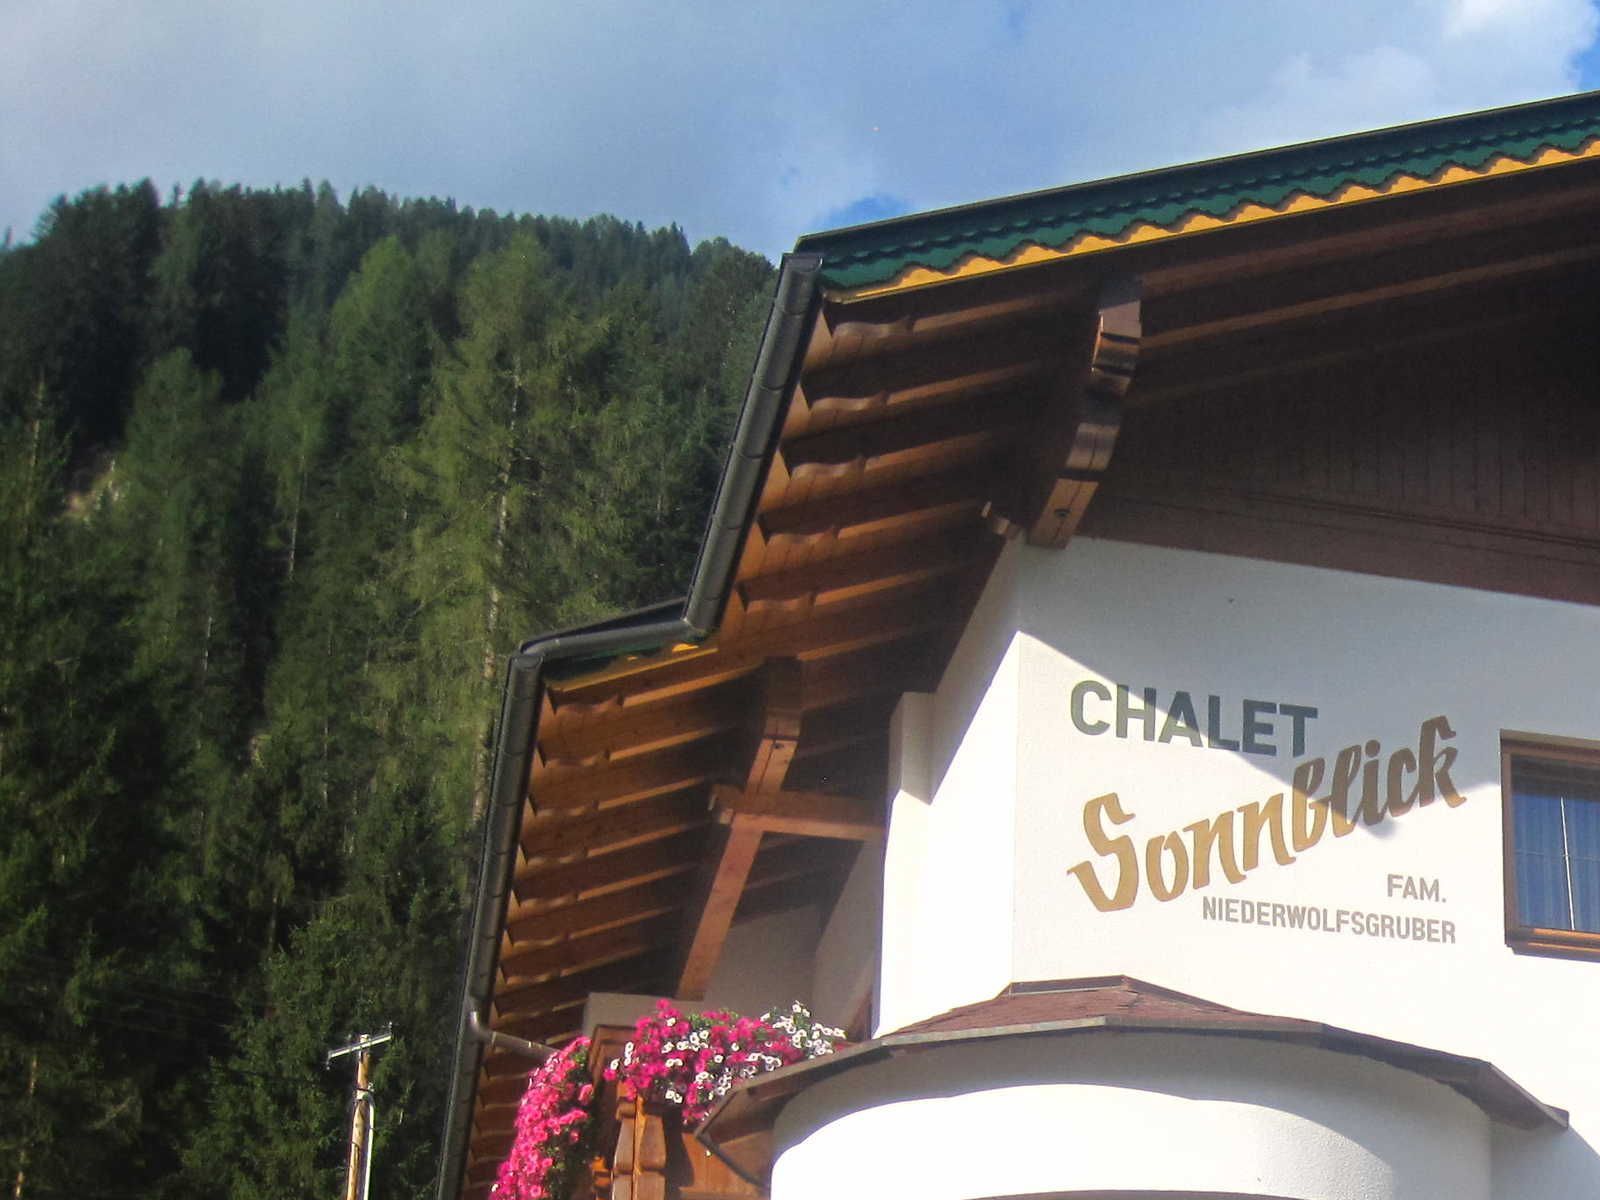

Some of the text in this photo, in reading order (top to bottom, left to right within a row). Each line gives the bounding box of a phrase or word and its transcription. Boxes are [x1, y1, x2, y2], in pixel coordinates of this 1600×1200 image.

[1070, 680, 1318, 758] CHALET
[1067, 715, 1467, 912] Sonnblick
[1202, 896, 1456, 944] NIEDERWOLFSGRUBER
[1387, 874, 1447, 904] FAM.
